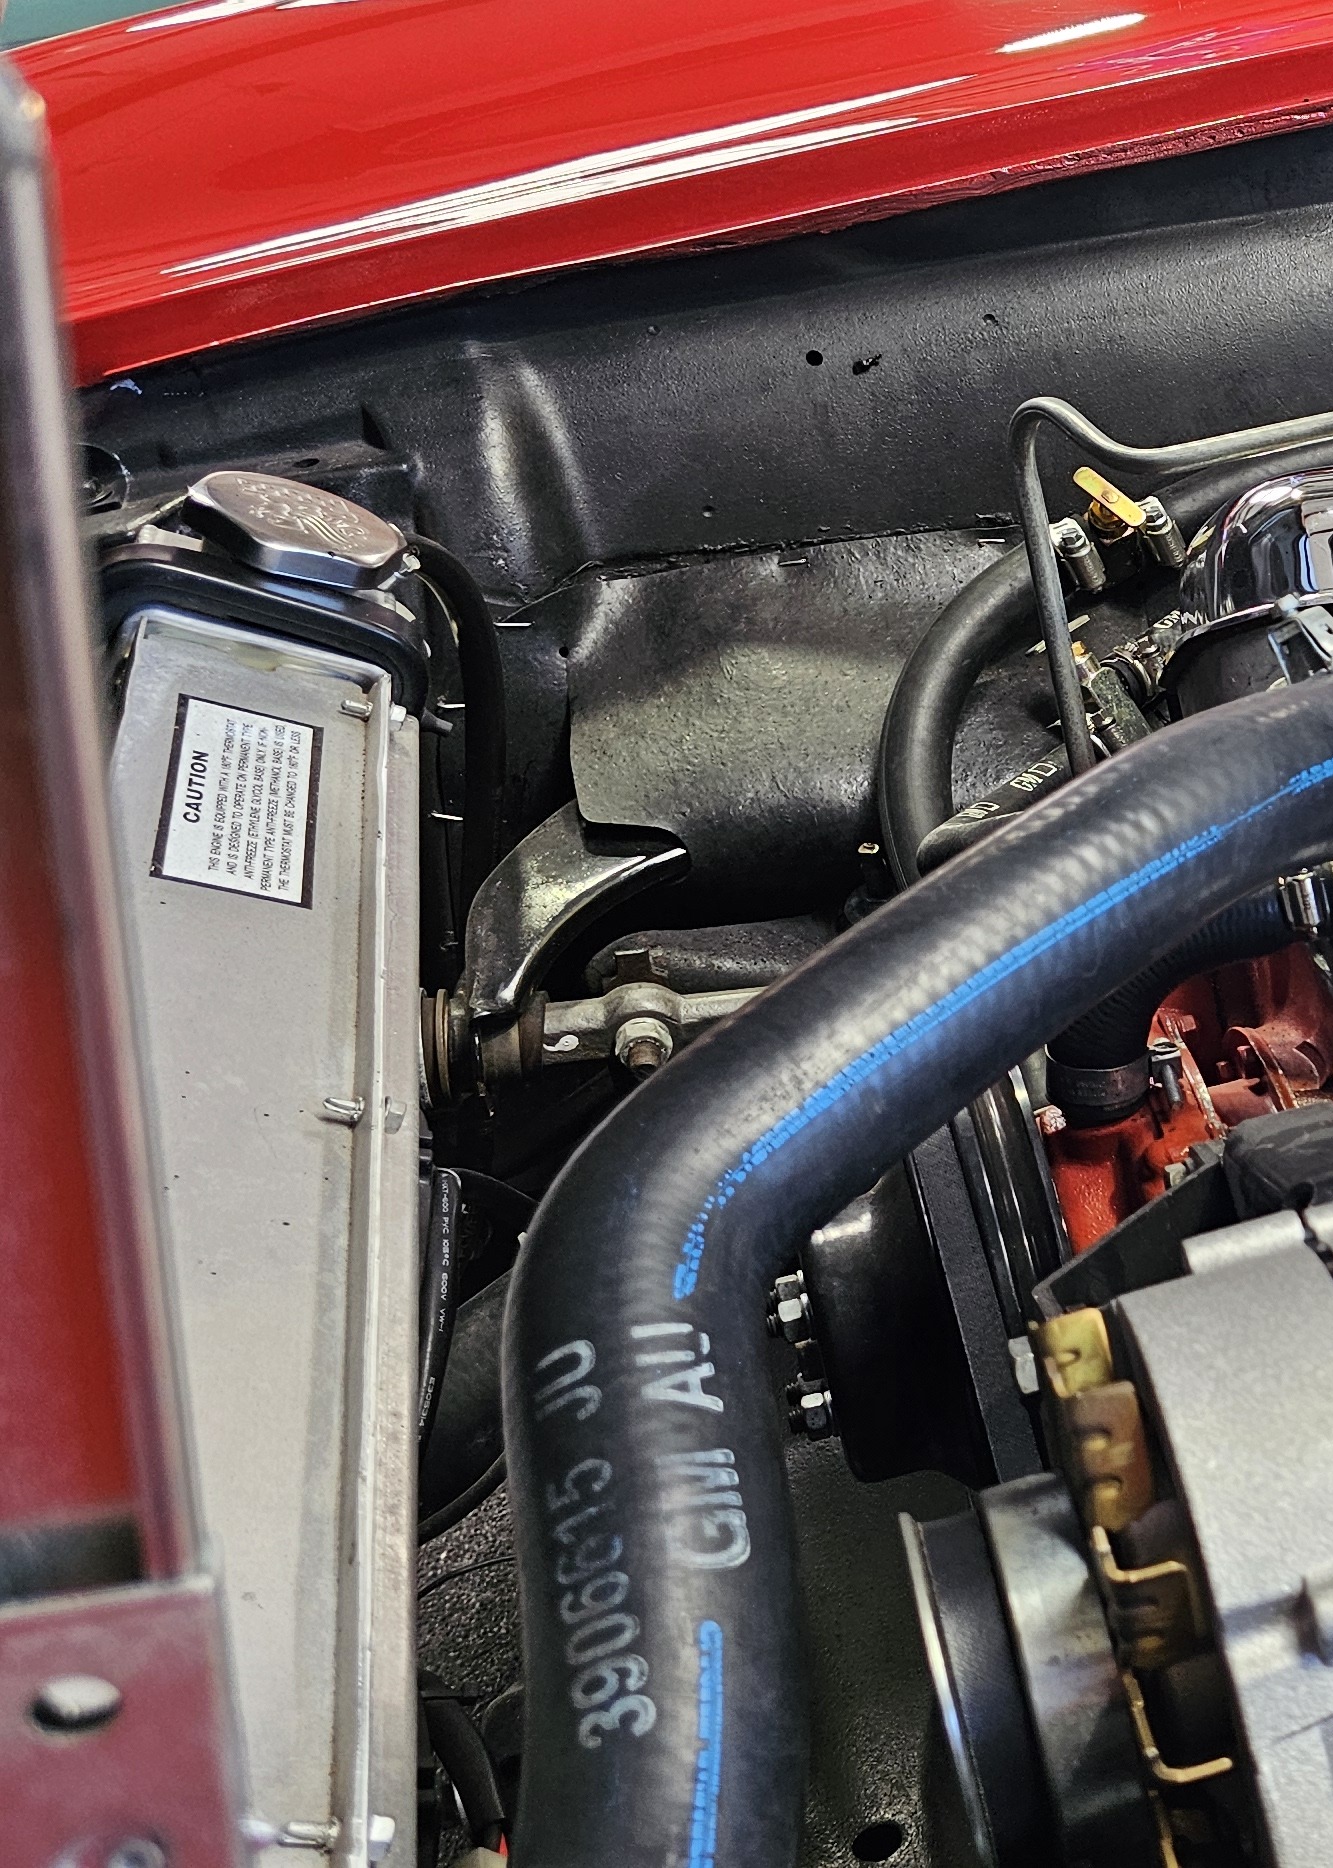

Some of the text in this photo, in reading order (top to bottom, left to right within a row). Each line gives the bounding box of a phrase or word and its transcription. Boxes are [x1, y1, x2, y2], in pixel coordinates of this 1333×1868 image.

[223, 718, 236, 753] THERMOSTAT
[242, 722, 254, 737] TYPE
[291, 730, 302, 744] LESS
[238, 737, 251, 772] PERMANENT
[289, 745, 300, 754] OR
[219, 776, 230, 792] WITH
[237, 771, 248, 782] ON
[287, 770, 298, 779] TO
[1010, 773, 1043, 792] GM
[183, 750, 209, 823] CAUTION
[233, 782, 247, 810] OPERATE
[284, 780, 297, 808] CHANGED
[214, 793, 228, 823] EQUIPPED
[232, 810, 244, 819] TO
[266, 798, 279, 836] ANTI-FREEZE
[284, 809, 296, 818] BE
[228, 821, 242, 852] DESIGNED
[283, 818, 294, 836] MUST
[210, 831, 224, 855] ENGINE
[264, 836, 276, 852] TYPE
[208, 856, 221, 870] THIS
[244, 839, 258, 879] ANTI-FREEZE
[279, 836, 293, 876] THERMOSTAT
[226, 861, 238, 875] AND
[260, 853, 274, 891] PERMANENT
[278, 877, 290, 890] THE
[441, 1216, 449, 1234] PVC
[440, 1272, 449, 1301] 600V
[630, 1322, 752, 1570] GM AU
[535, 1339, 657, 1750] 3906615 JU
